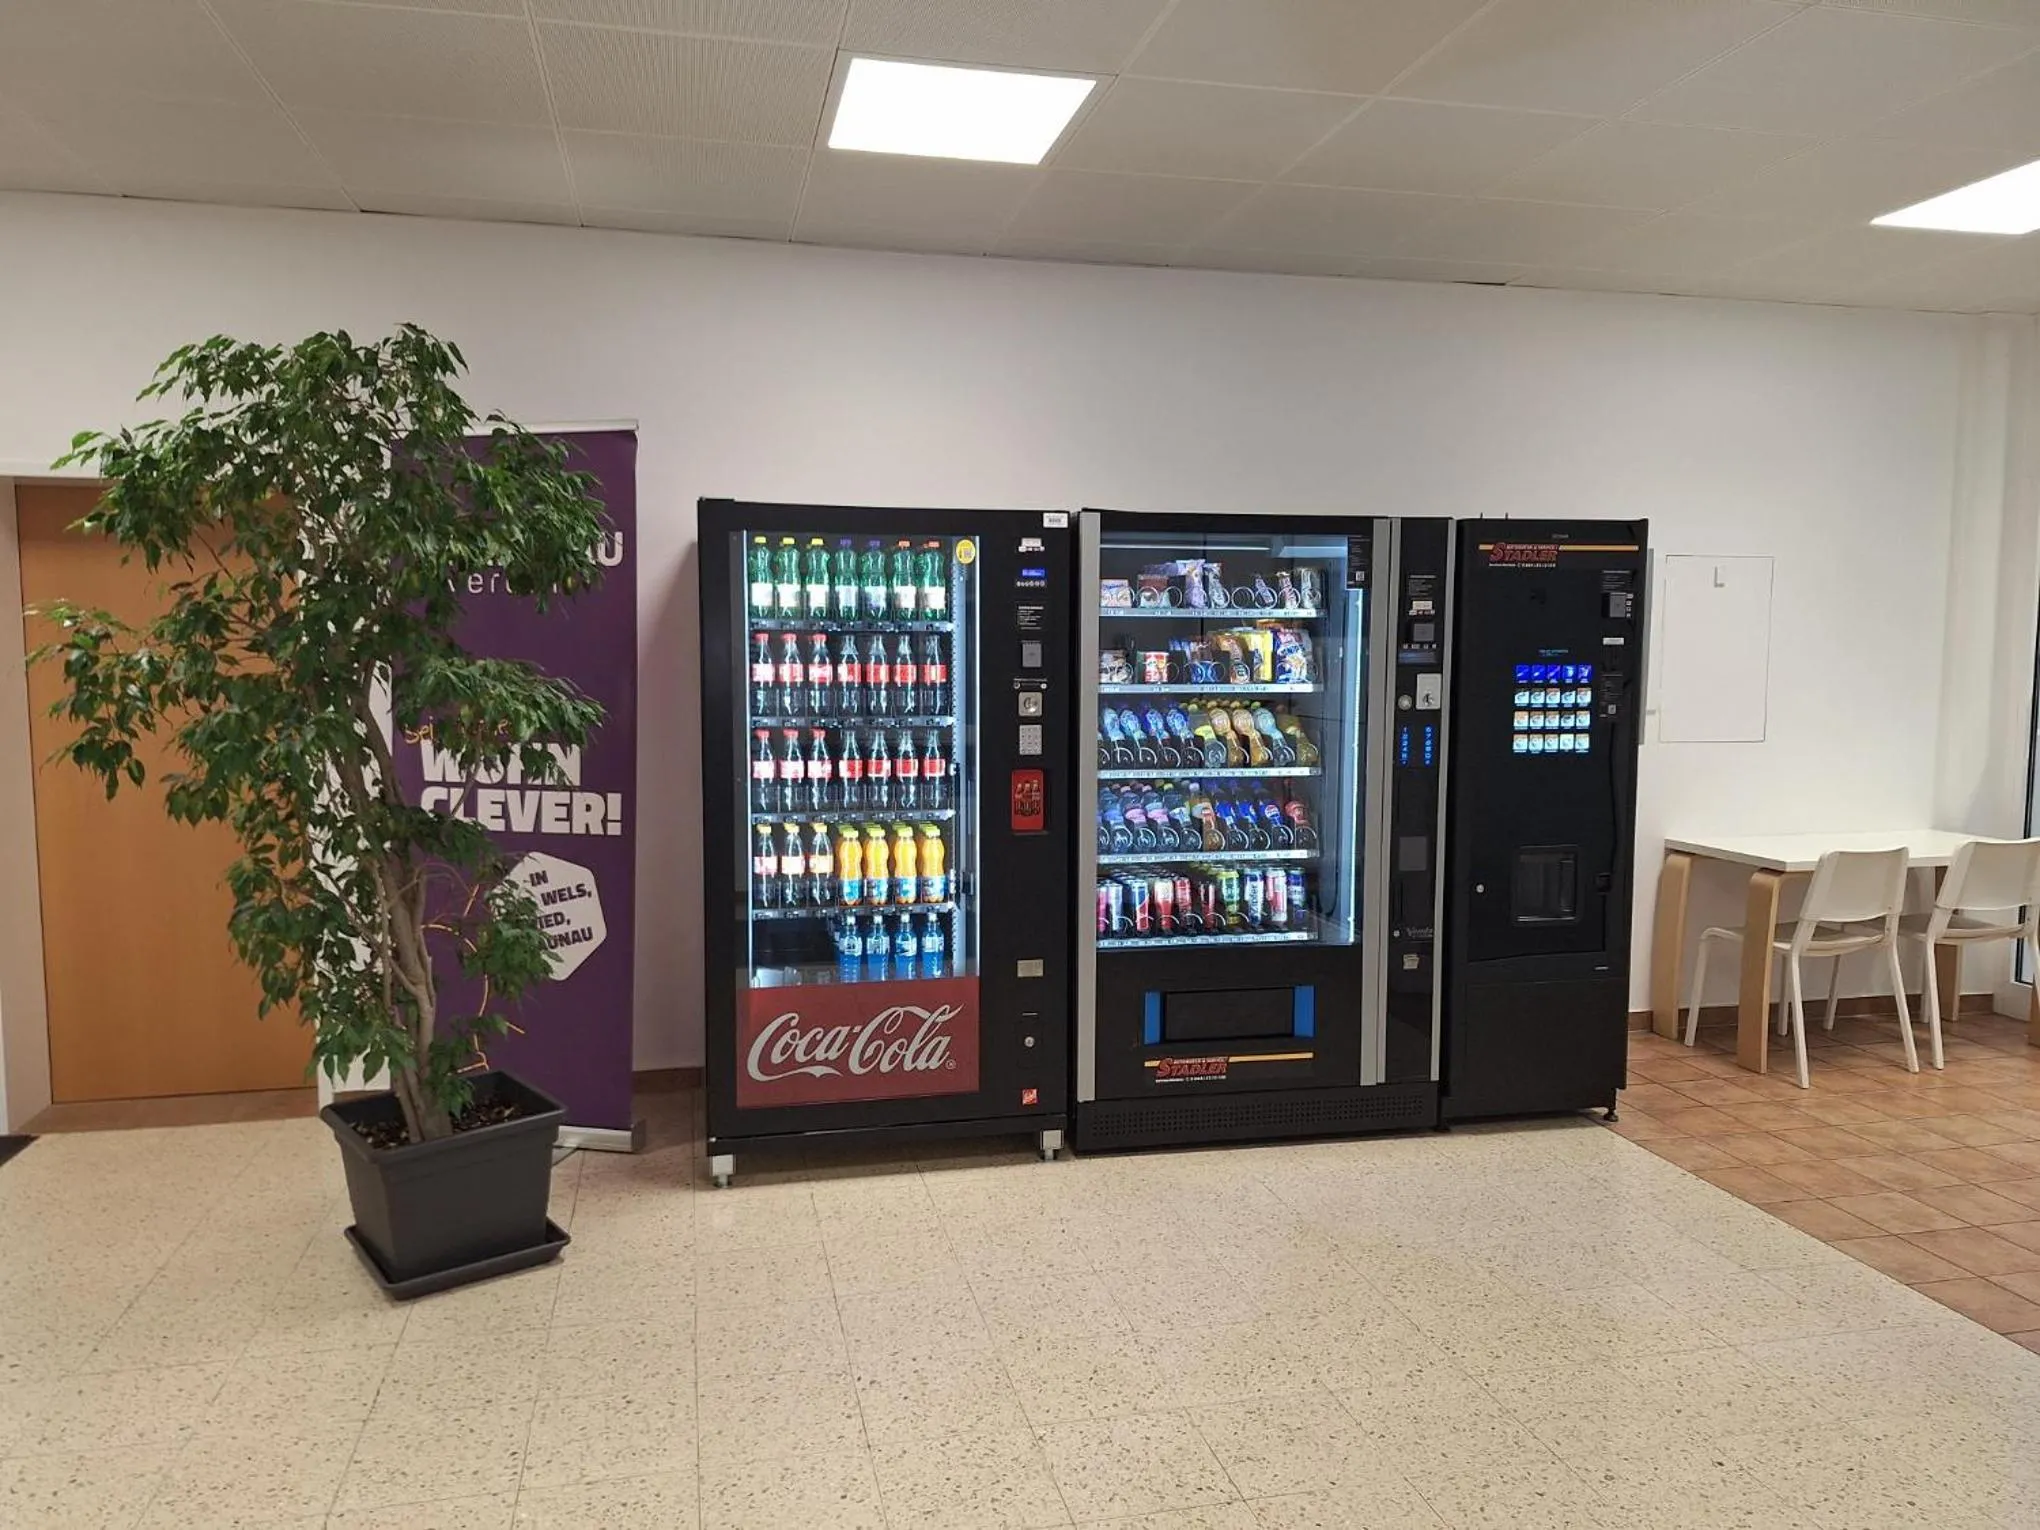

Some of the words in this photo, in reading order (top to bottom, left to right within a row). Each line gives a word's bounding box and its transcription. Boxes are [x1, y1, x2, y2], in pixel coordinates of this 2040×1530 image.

[421, 786, 622, 836] CLEVER!
[529, 870, 549, 887] IN
[540, 883, 592, 907] WELS,
[537, 911, 571, 929] IED,
[546, 926, 594, 950] UNAU
[747, 1002, 965, 1082] Coca-Cola
